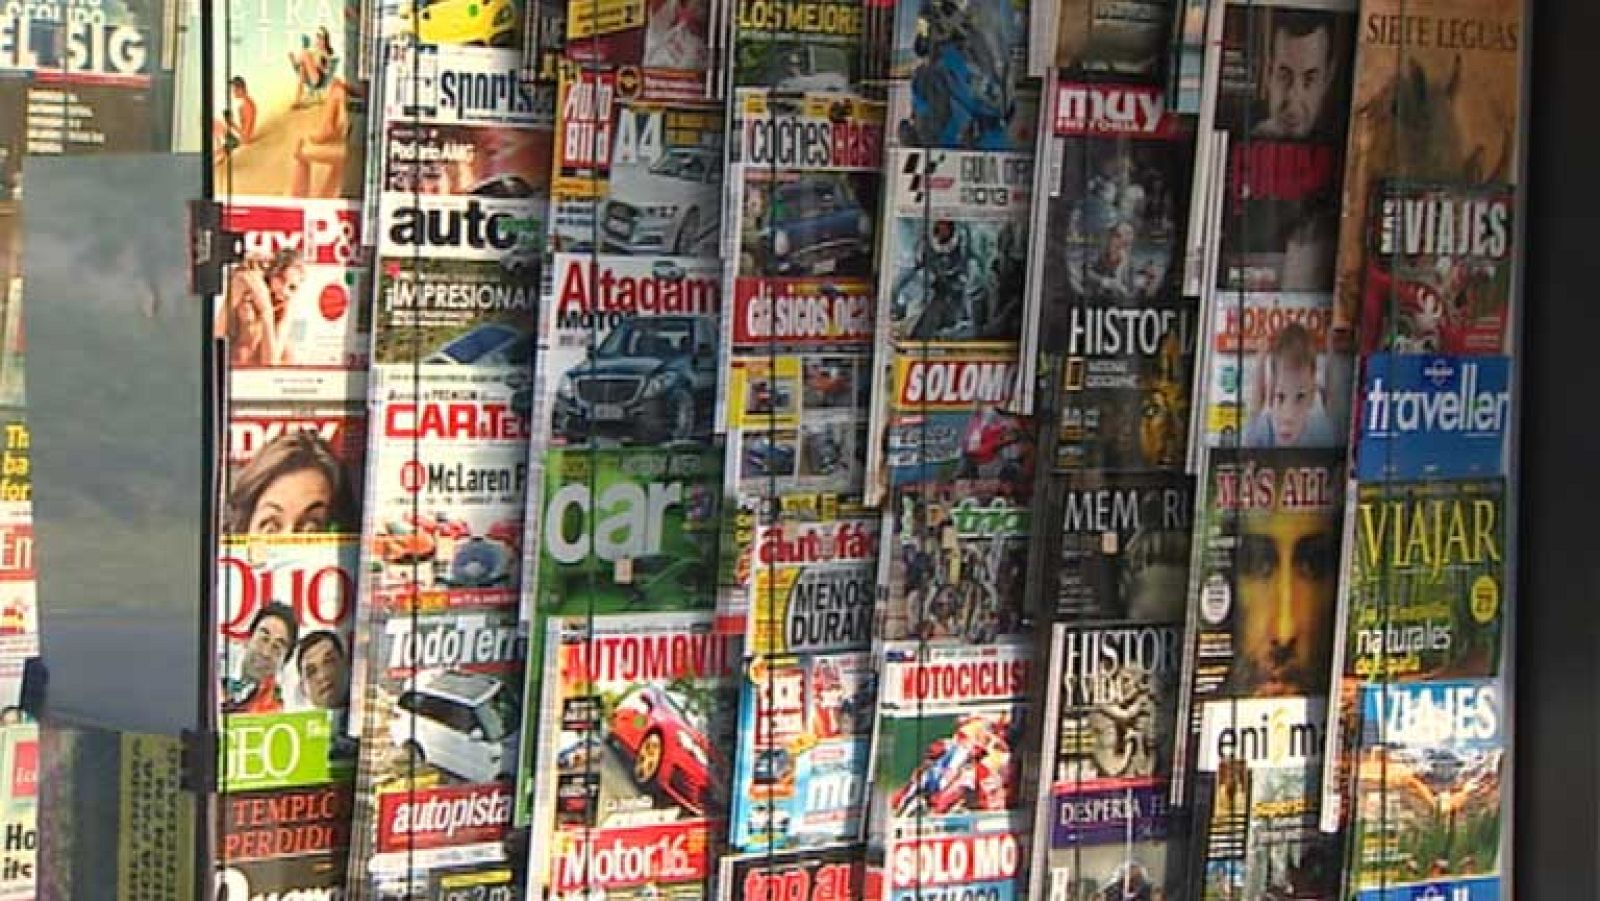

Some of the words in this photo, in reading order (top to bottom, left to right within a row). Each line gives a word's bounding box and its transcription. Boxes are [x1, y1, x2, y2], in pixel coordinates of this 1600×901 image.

[1367, 14, 1432, 47] SIETE
[1059, 88, 1165, 132] muy
[1405, 198, 1508, 257] VIAJES
[1368, 363, 1511, 433] traveller
[428, 463, 510, 494] McLaren
[547, 483, 683, 563] car
[1359, 499, 1501, 580] VIAJAR
[393, 789, 512, 836] autopista
